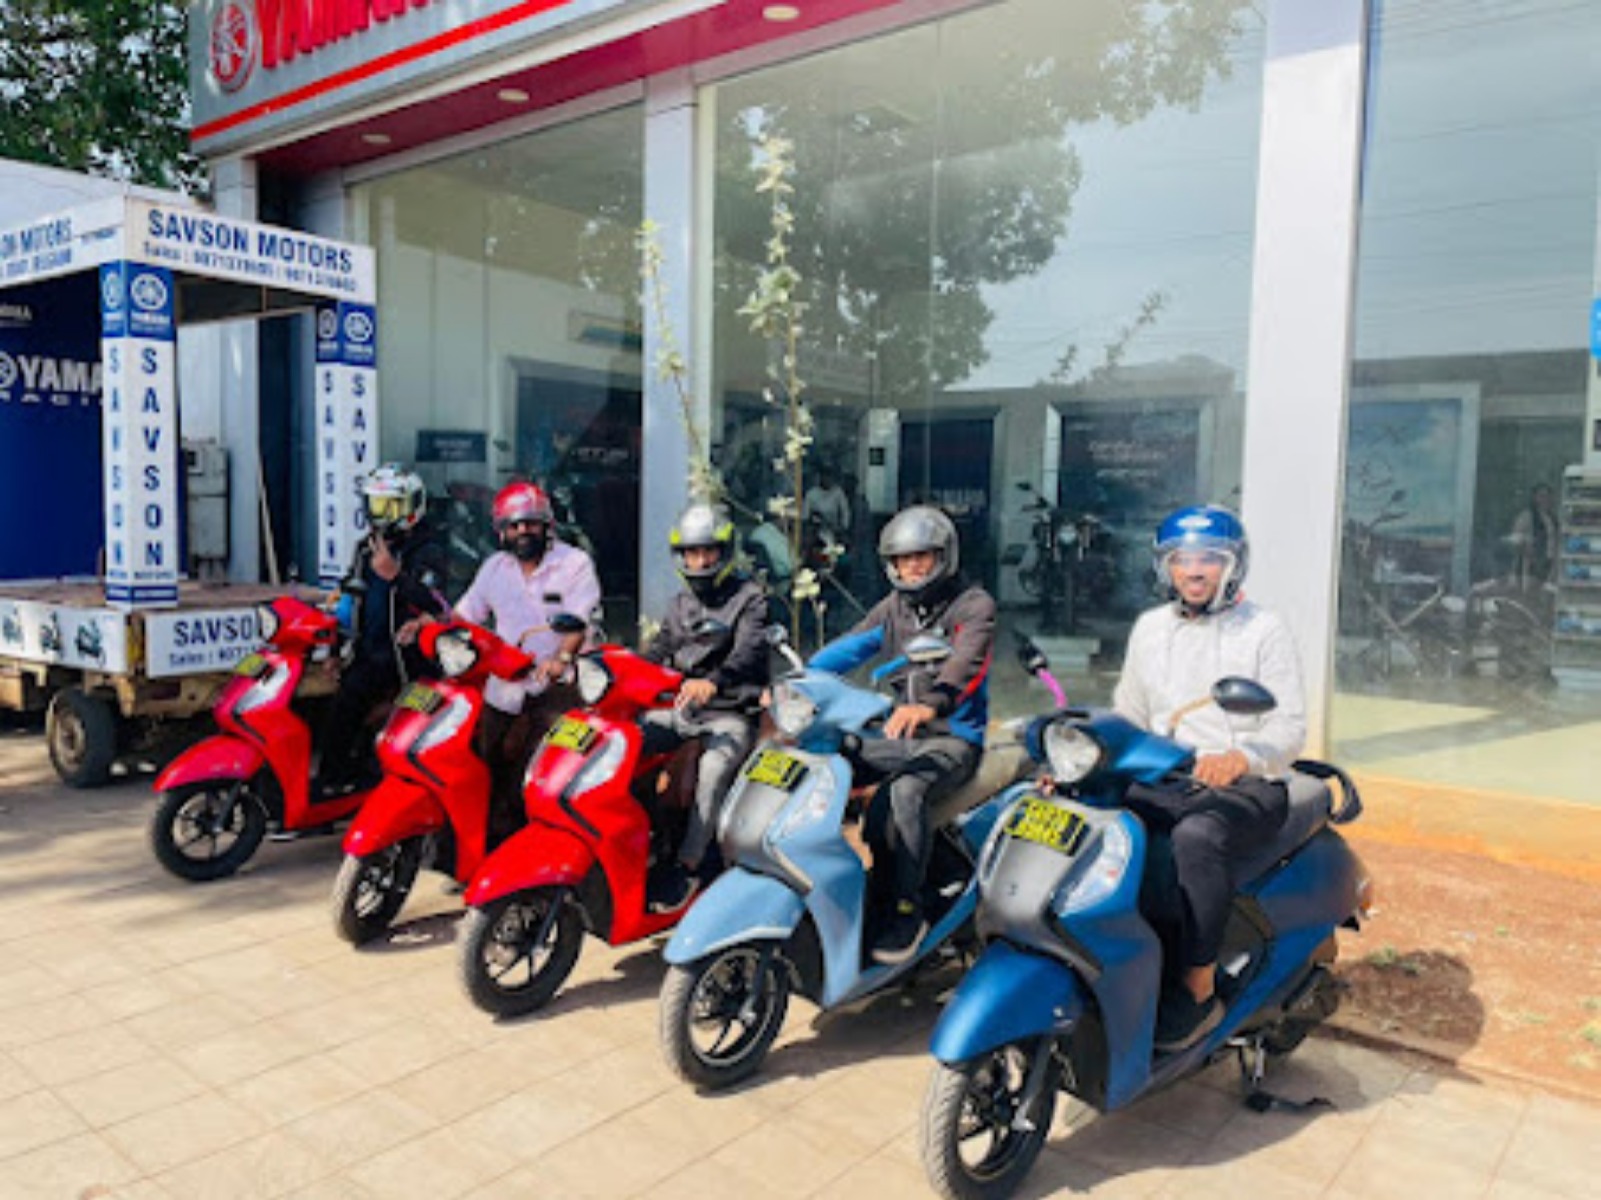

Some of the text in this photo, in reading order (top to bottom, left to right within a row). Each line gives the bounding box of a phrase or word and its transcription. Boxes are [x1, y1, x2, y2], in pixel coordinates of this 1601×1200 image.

[148, 208, 249, 253] SAVSON
[257, 231, 352, 274] MOTORS
[350, 372, 368, 530] SAVSO
[173, 614, 254, 647] SAVSO
